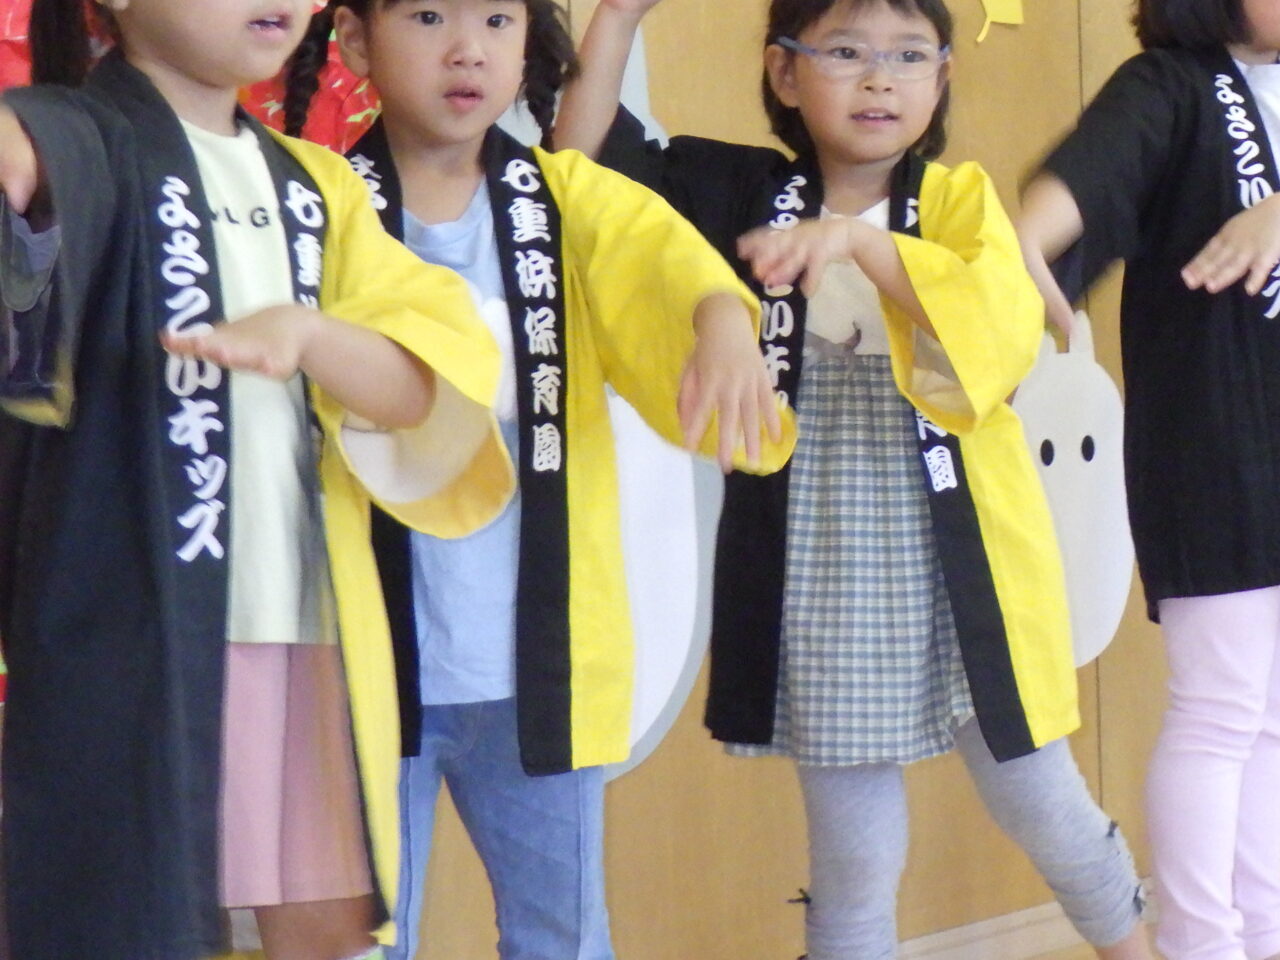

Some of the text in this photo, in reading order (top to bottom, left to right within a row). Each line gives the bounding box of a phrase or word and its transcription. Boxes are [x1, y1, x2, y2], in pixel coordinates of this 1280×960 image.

[500, 158, 562, 473] 七重浜保育園
